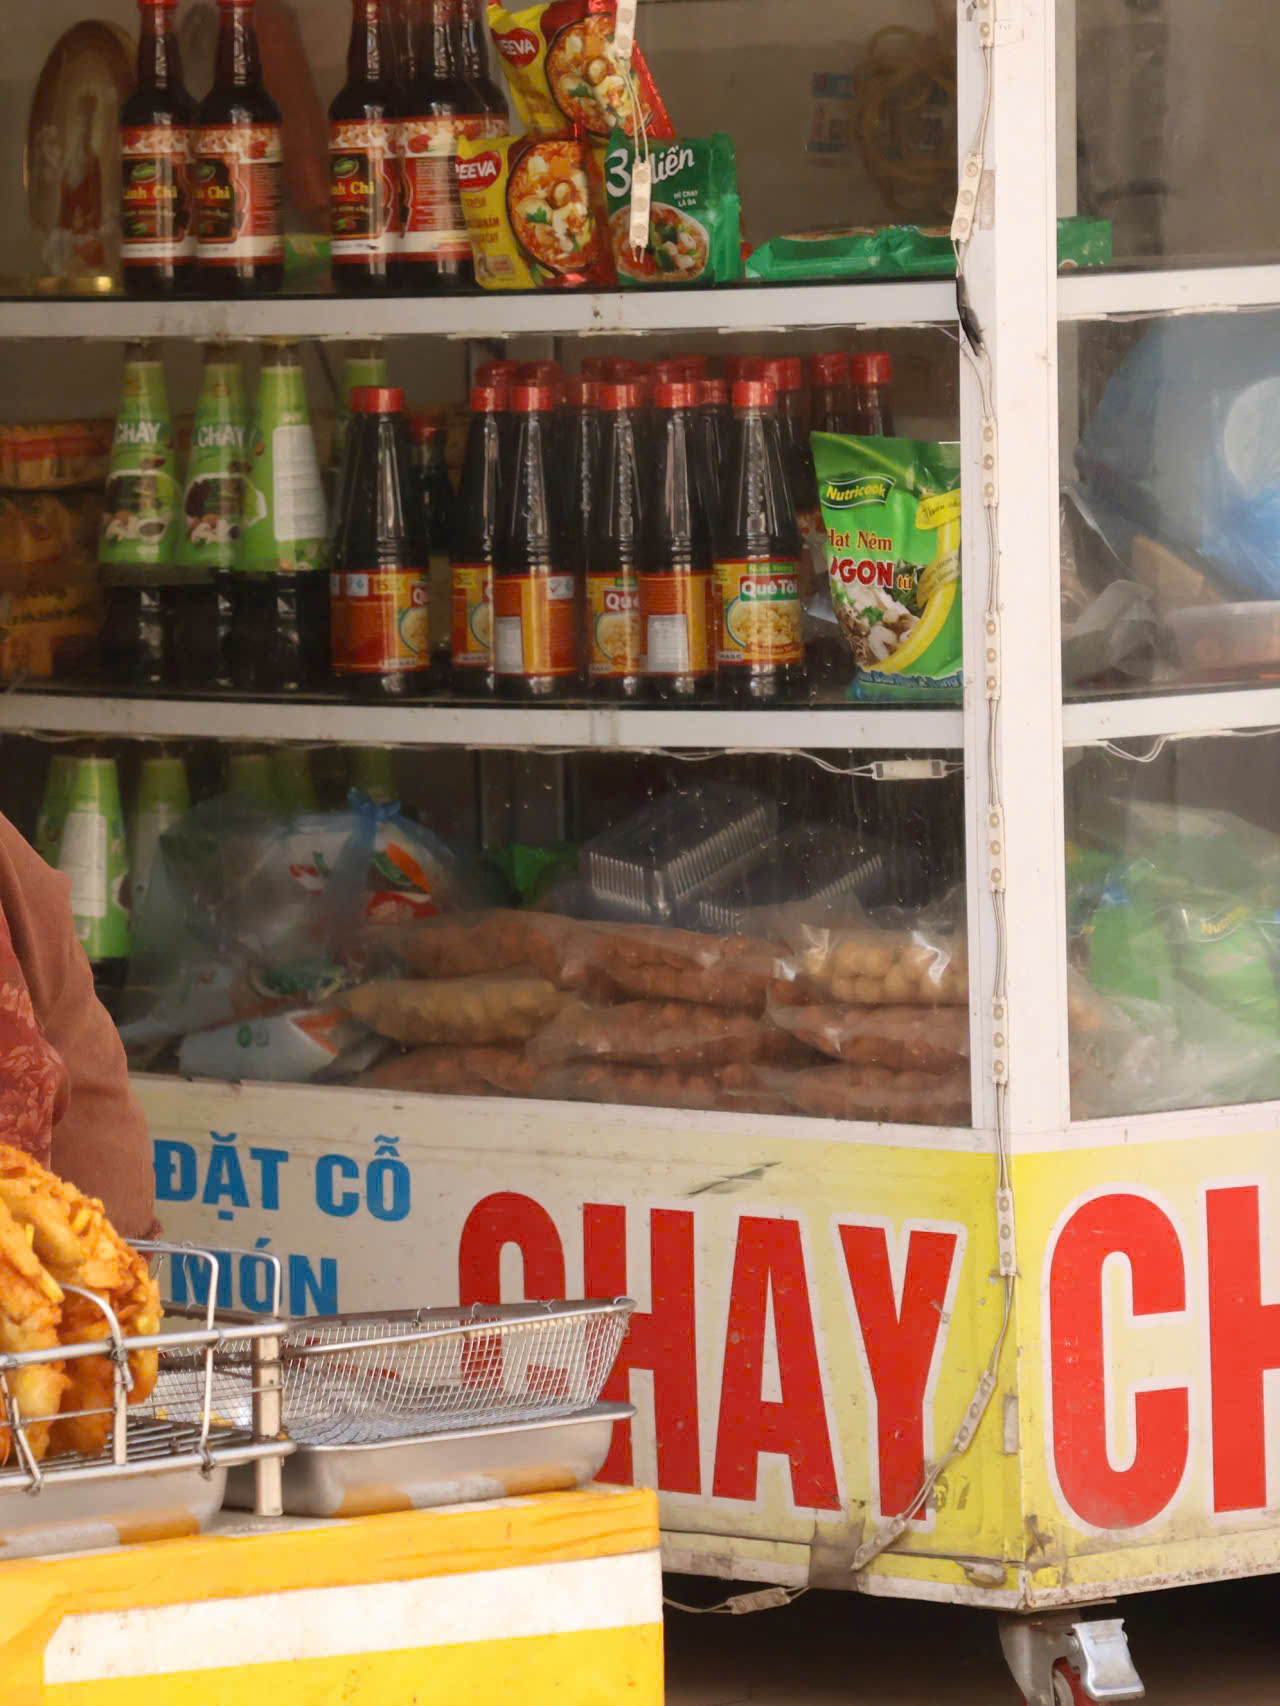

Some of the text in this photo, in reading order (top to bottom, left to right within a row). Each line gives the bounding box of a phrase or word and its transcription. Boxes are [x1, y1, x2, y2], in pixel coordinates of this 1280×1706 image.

[605, 149, 632, 198] 3
[197, 424, 245, 448] CHAY
[825, 484, 887, 501] Nutricook
[857, 530, 893, 552] Nêm
[741, 579, 778, 599] Quê
[153, 1131, 412, 1222] ĐẶT CỖ
[170, 1237, 339, 1317] MÓN
[458, 1190, 959, 1521] CHAY
